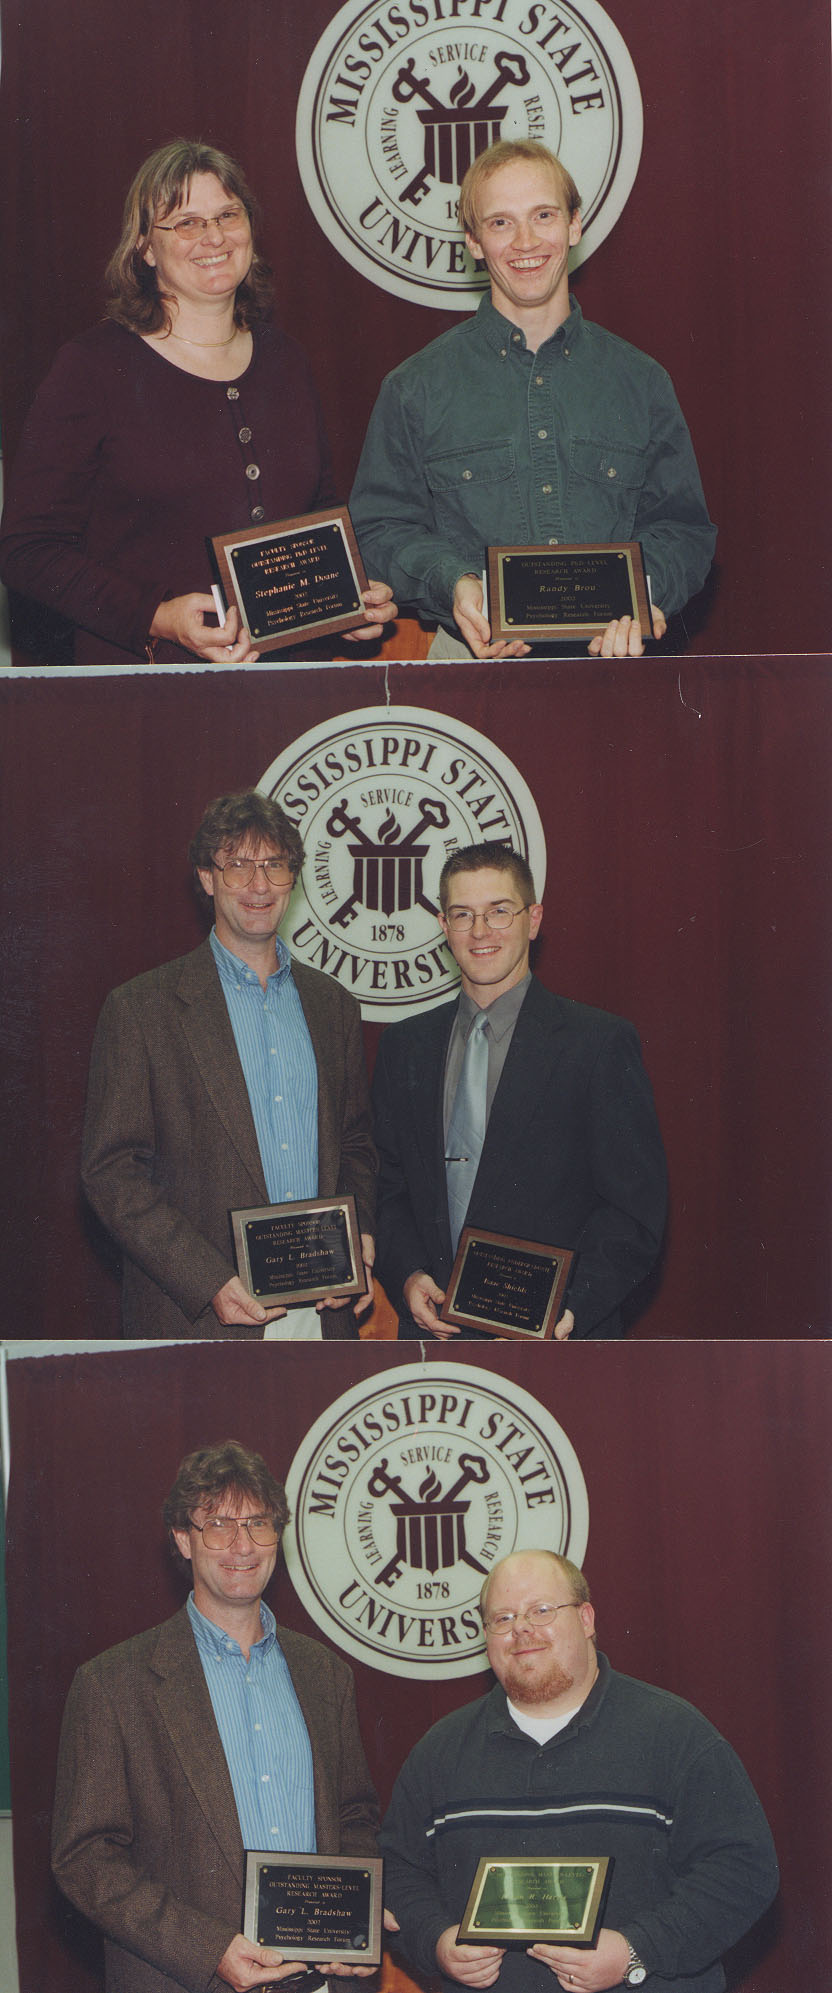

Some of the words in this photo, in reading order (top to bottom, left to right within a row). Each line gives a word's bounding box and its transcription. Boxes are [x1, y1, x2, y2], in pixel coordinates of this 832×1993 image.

[326, 0, 506, 127] MISSISSIPPI
[518, 4, 605, 115] STATE
[429, 43, 489, 67] SERVICE
[380, 106, 409, 181] LEARNING
[358, 196, 489, 274] UNIVE
[255, 582, 296, 599] Stephanie
[539, 585, 569, 593] Randy
[283, 736, 438, 829] ISSISSIPPI
[360, 788, 414, 808] SERVICE
[313, 840, 338, 906] LEARNING
[371, 924, 405, 942] 1878
[265, 1256, 283, 1264] Gary
[300, 1249, 335, 1259] Bradshaw
[308, 1393, 476, 1519] MISSISSIPPI
[479, 1412, 557, 1509] STATE
[400, 1445, 454, 1466] SERVICE
[357, 1500, 383, 1566] LEARNING
[480, 1491, 504, 1561] RESEARCH
[415, 1581, 451, 1600] 1878
[339, 1579, 488, 1648] UNIVERS
[275, 1906, 296, 1915] Gary
[314, 1908, 352, 1917] Bradshaw
